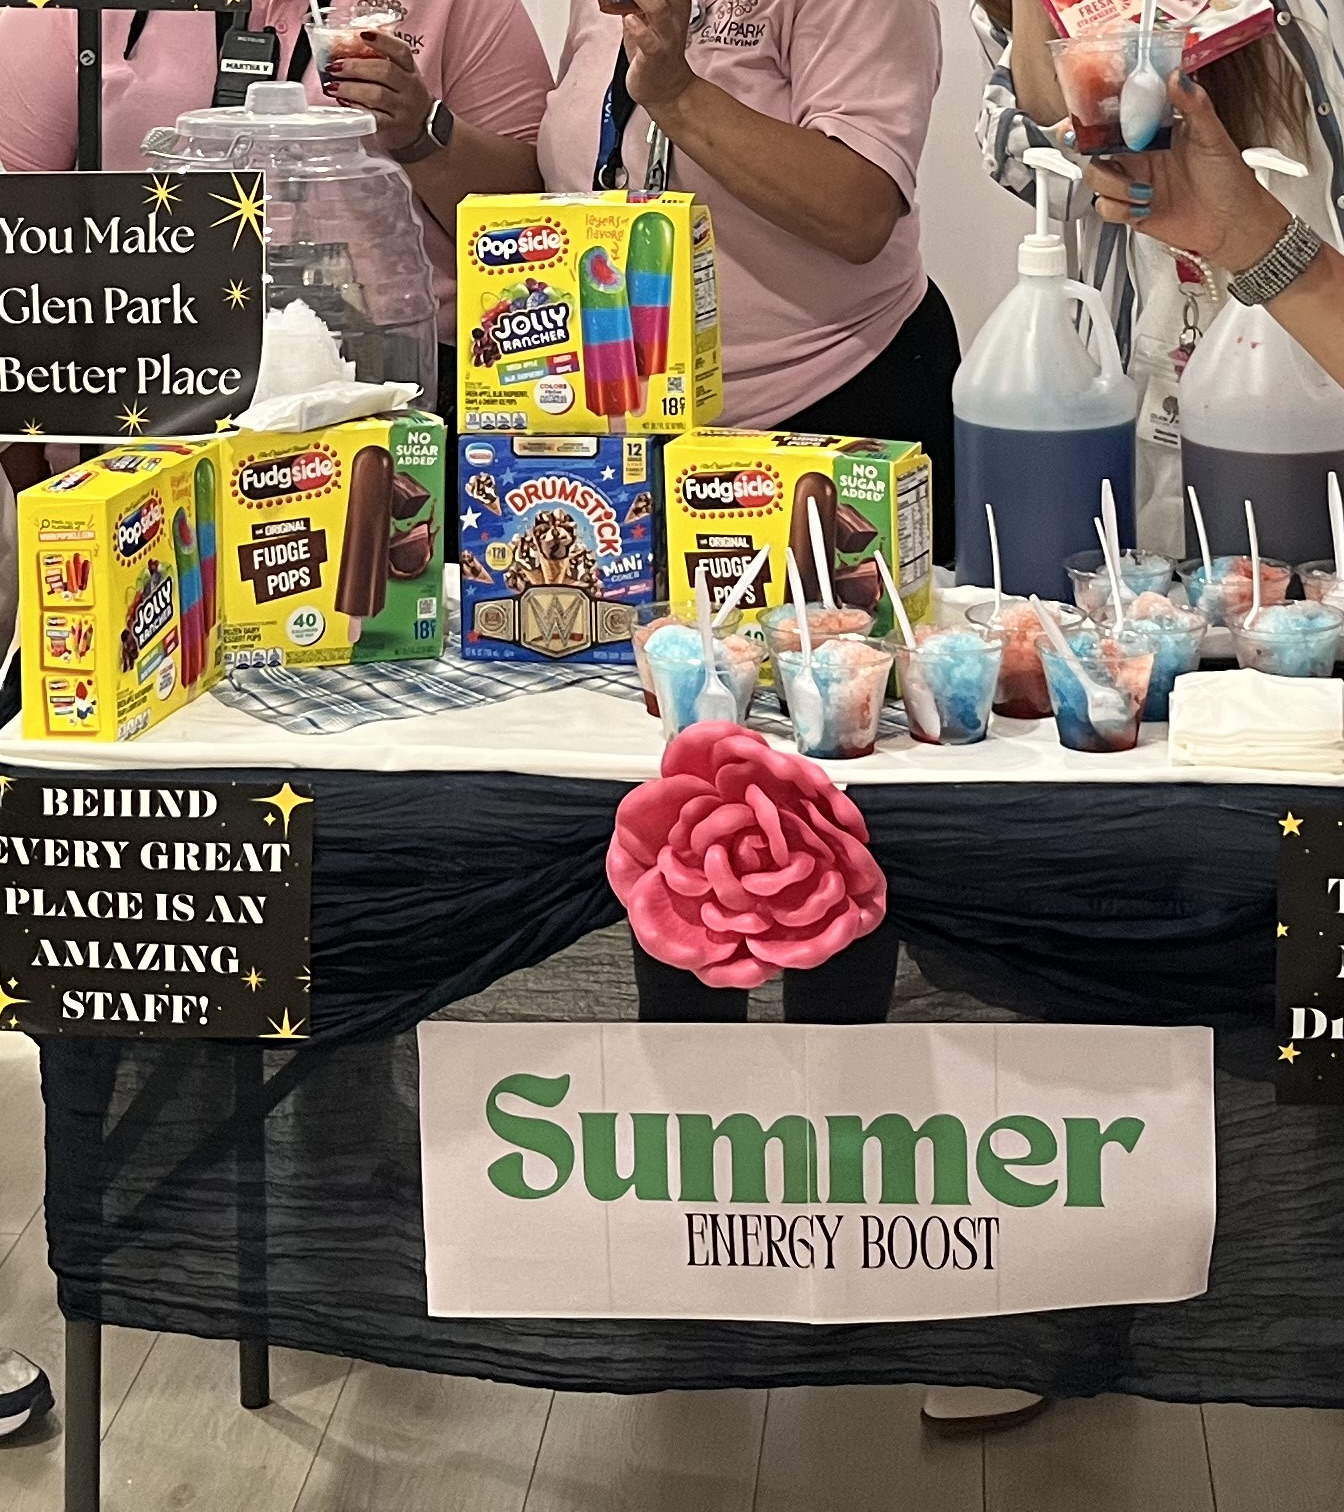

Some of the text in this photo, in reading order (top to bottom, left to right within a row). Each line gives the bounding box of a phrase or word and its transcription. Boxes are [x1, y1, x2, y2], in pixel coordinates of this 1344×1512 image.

[727, 22, 766, 38] PARK
[84, 212, 195, 254] Make
[104, 283, 198, 324] Park
[494, 302, 569, 340] JOLLY
[503, 329, 567, 353] RANCHER
[137, 353, 242, 395] Place
[662, 397, 678, 415] 18
[396, 444, 438, 457] SUGAR
[408, 432, 431, 445] NO
[627, 443, 642, 456] 12
[242, 457, 334, 491] Fudgsicle
[840, 474, 886, 493] SUGAR
[853, 463, 878, 477] NO
[685, 474, 776, 502] Fudgsicle
[265, 520, 306, 536] ORIGINAL
[709, 537, 750, 548] ORIGINAL
[253, 539, 311, 570] FUDGE
[267, 566, 311, 595] POPS
[714, 585, 756, 603] POS
[134, 581, 172, 634] JOLLY
[293, 613, 317, 628] 40
[413, 619, 429, 640] 18
[42, 787, 218, 818] BEHIND
[140, 840, 291, 872] GREAT
[5, 887, 267, 924] PLACE IS AN
[31, 939, 240, 974] AMAZING
[62, 990, 209, 1025] STAFF!
[485, 1072, 1147, 1208] Summer
[686, 1213, 1001, 1271] ENERGY BOOST
